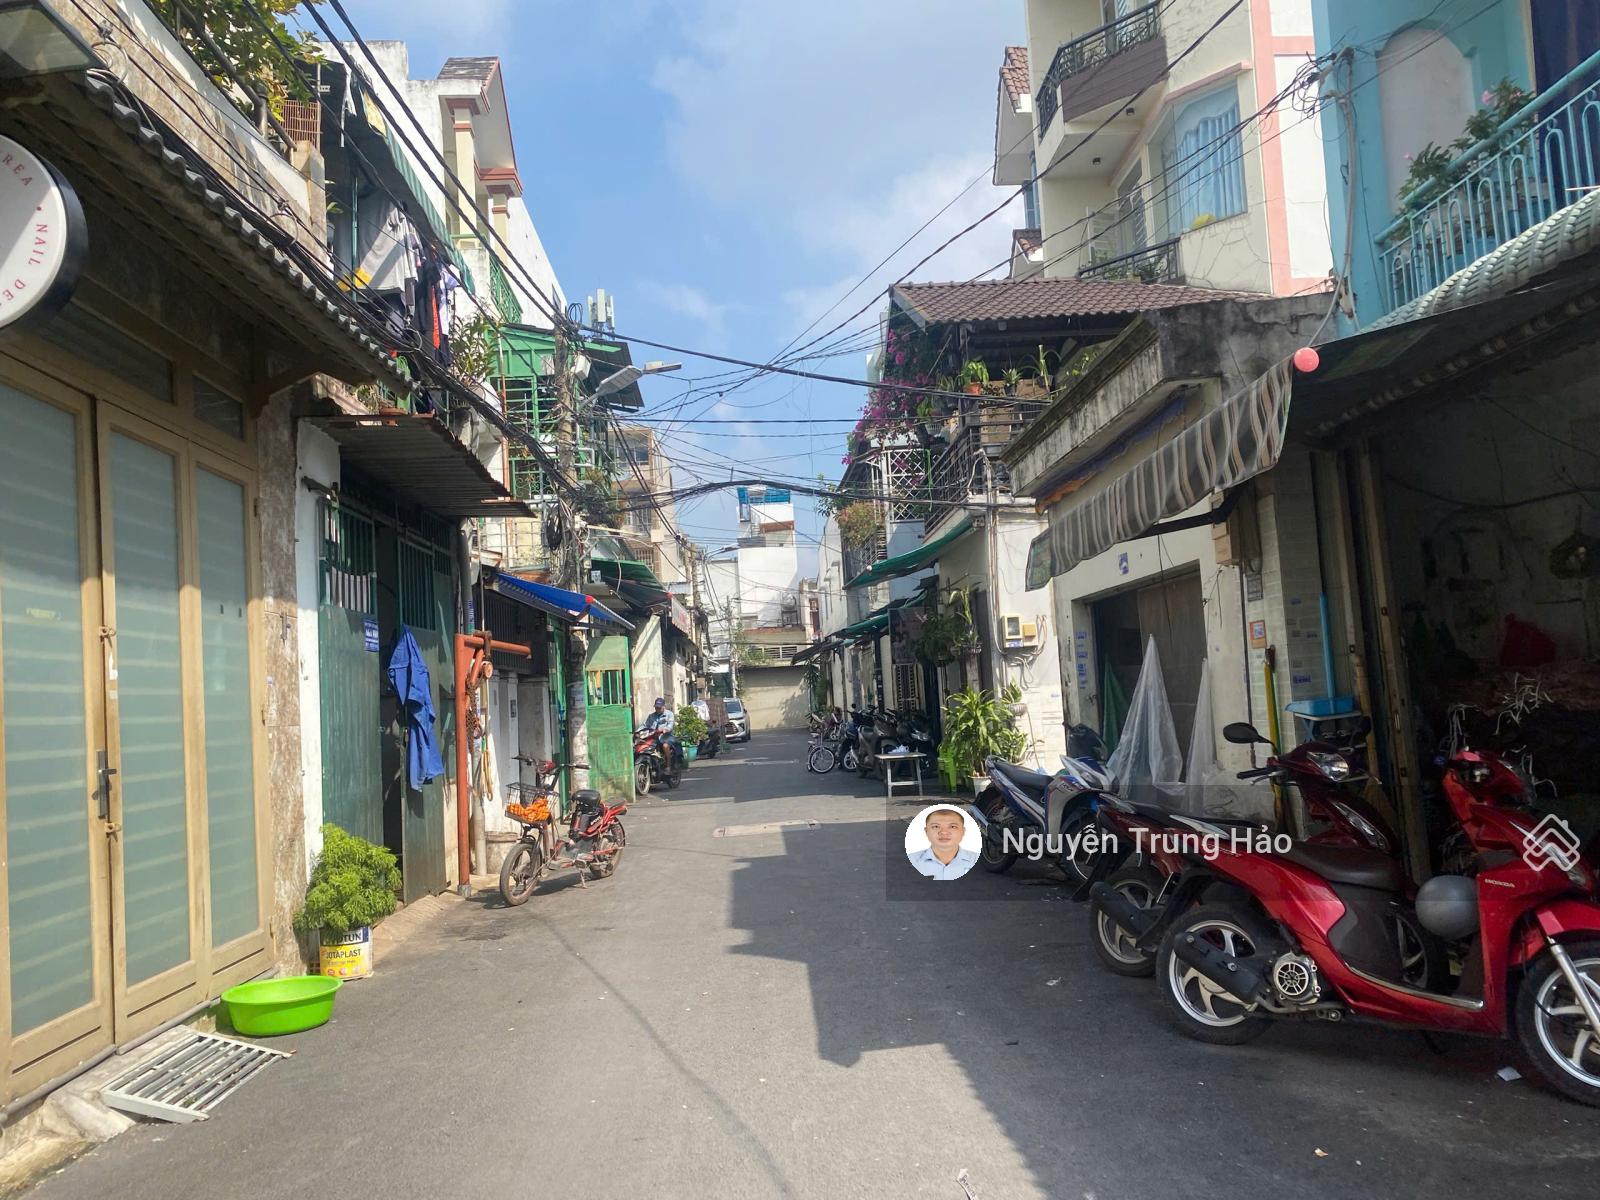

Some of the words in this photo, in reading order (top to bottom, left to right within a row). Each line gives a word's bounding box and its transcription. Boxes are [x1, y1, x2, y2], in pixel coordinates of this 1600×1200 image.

[28, 223, 48, 266] NAIL
[0, 278, 26, 305] DE
[326, 948, 361, 959] JOTAPLAST
